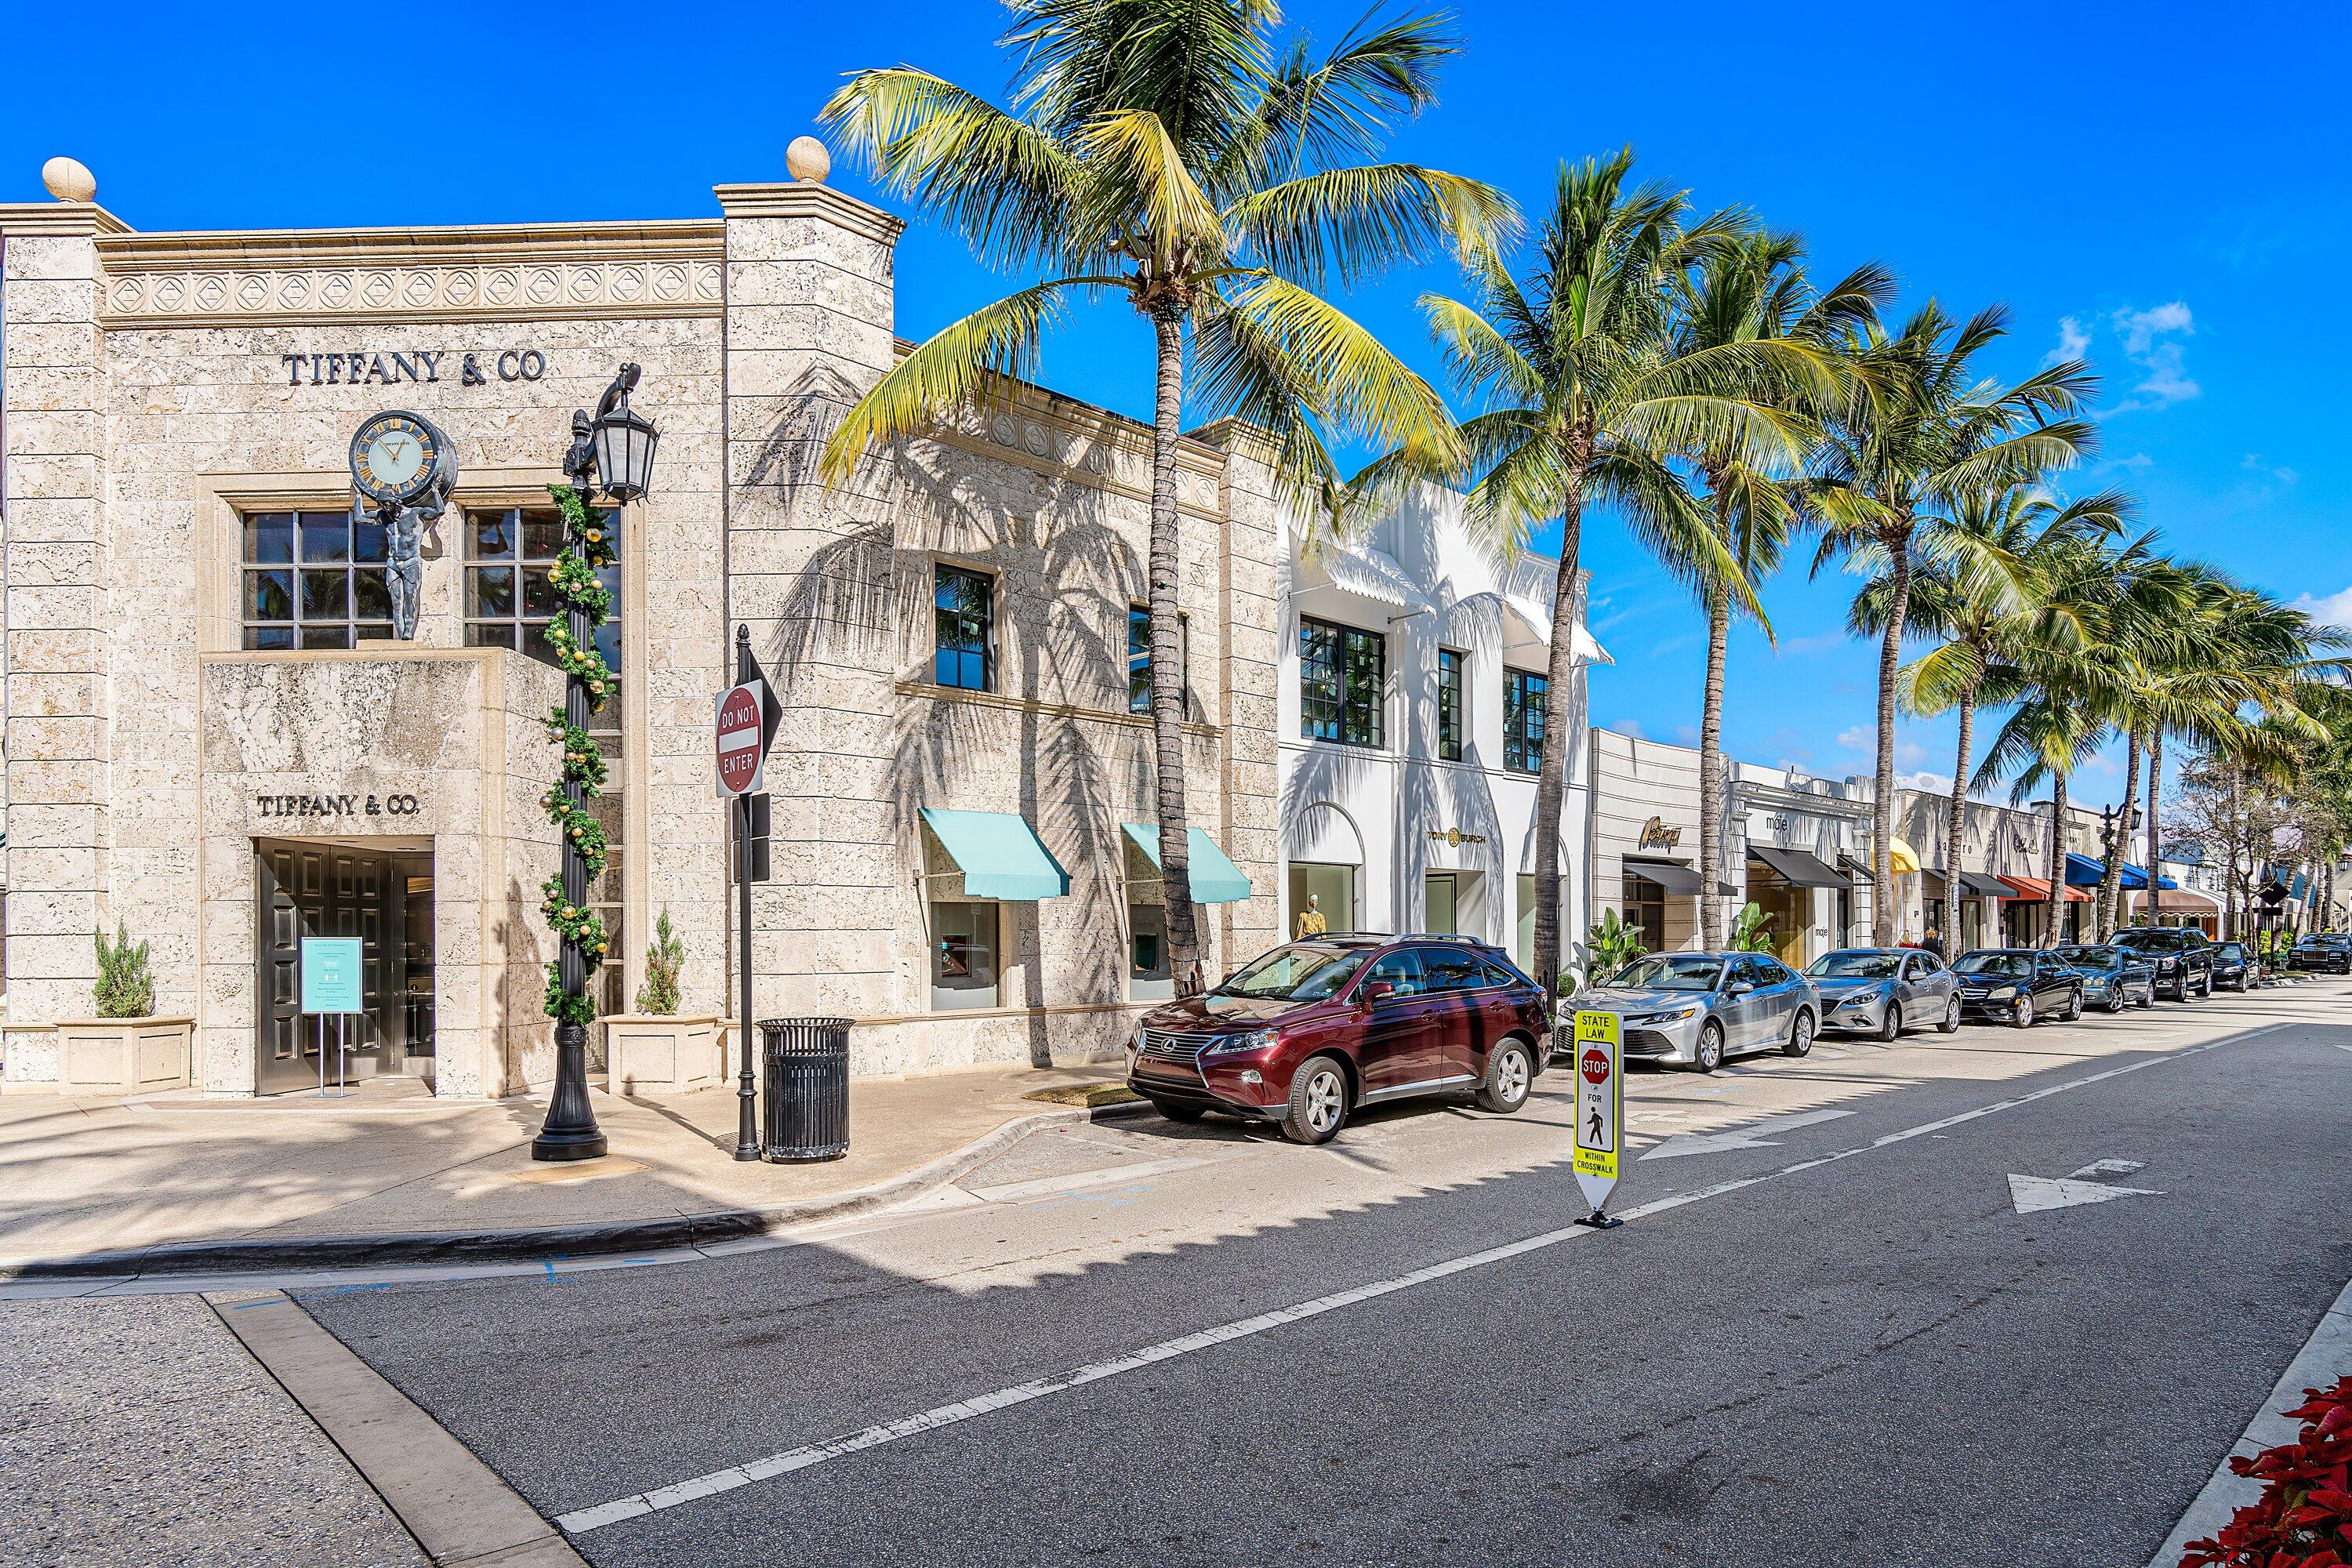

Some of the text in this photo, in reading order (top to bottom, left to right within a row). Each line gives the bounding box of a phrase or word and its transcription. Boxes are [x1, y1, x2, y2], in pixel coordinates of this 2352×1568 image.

[282, 350, 546, 387] TIFFANY & CO
[722, 704, 754, 728] DO NOT
[724, 753, 753, 774] ENTER
[257, 794, 358, 816] TIFFANY
[365, 794, 381, 815] &
[1766, 815, 1788, 833] maje
[1461, 833, 1486, 844] BURCH
[1936, 840, 1972, 854] saro
[1582, 1015, 1610, 1027] STATE
[1586, 1028, 1605, 1039] LAW
[1583, 1060, 1608, 1073] STOP
[1588, 1094, 1602, 1103] FOR
[1584, 1152, 1606, 1162] WITHIN
[1577, 1160, 1613, 1174] CROSSWALK
